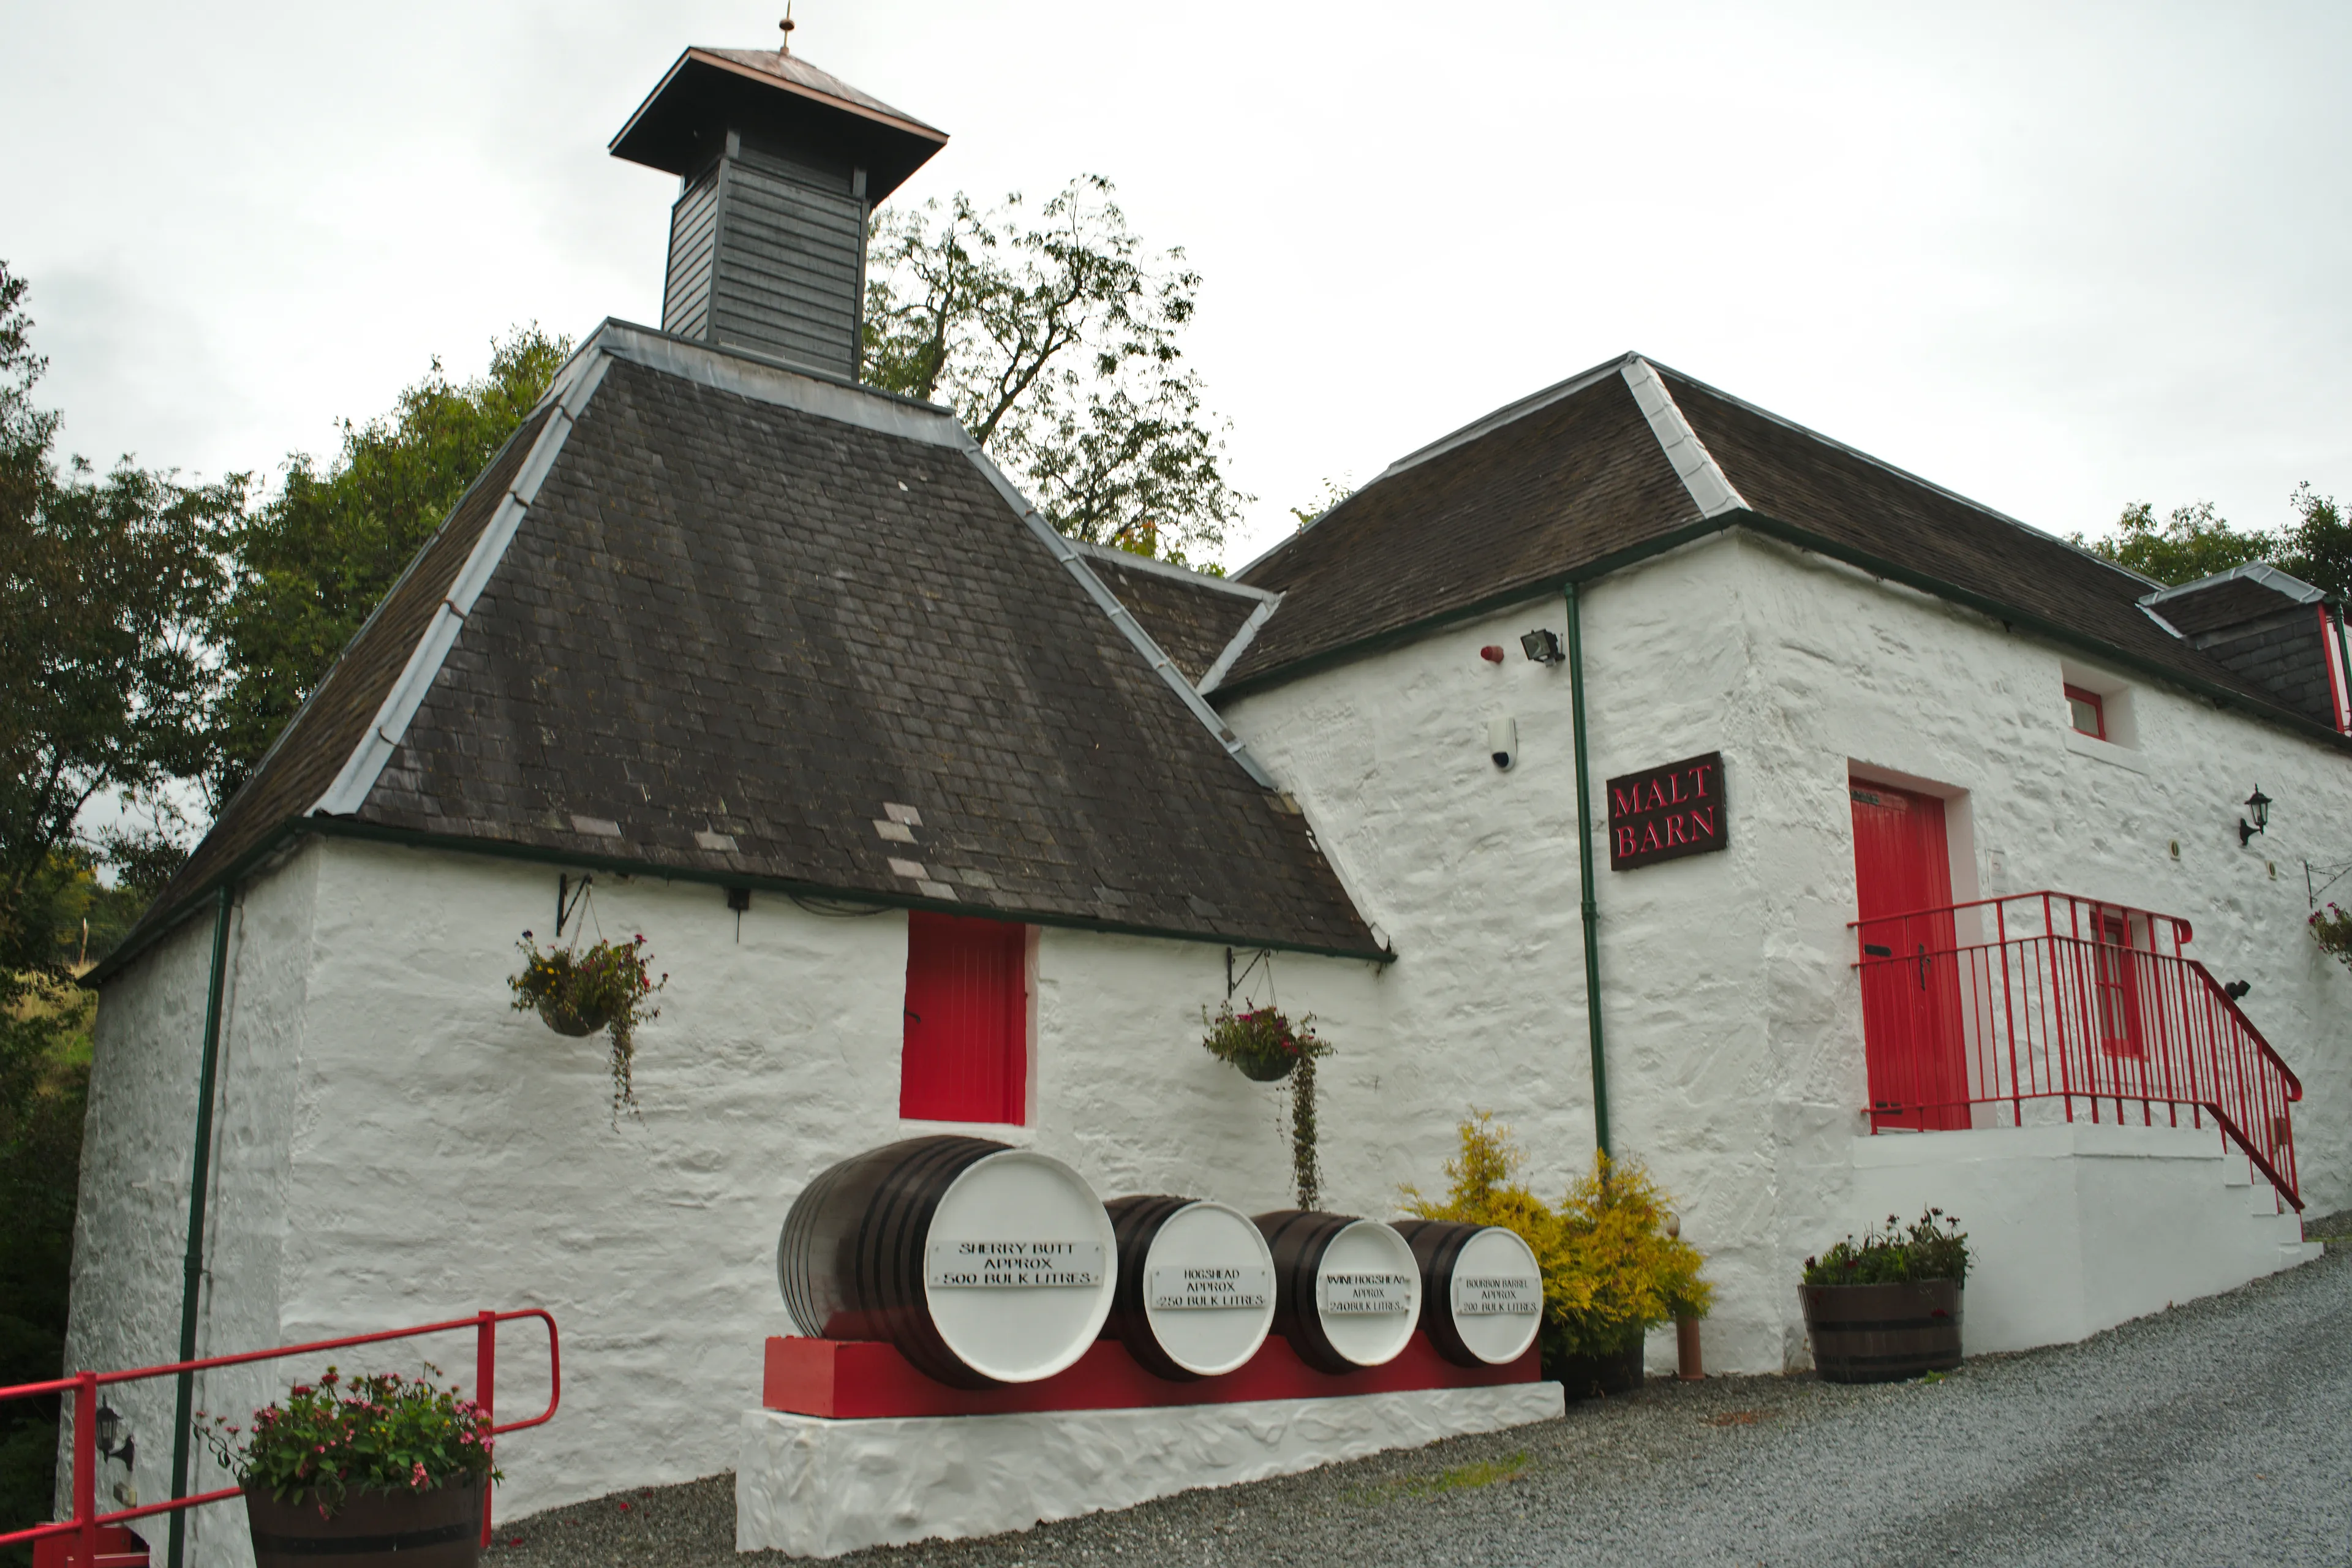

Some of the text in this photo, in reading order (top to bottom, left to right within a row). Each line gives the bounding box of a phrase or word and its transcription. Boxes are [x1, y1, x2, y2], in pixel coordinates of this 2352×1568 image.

[1613, 764, 1711, 818] MALT
[1616, 805, 1714, 858] BARN
[959, 1243, 1075, 1254] SHERRY BUTT
[984, 1257, 1052, 1269] APPROX
[944, 1272, 1090, 1284] 500 BULK LITRES
[1185, 1269, 1240, 1280] HOGSHEAD
[1187, 1281, 1235, 1292] APPROX
[1466, 1279, 1529, 1288] BOURBON BARREL
[1353, 1288, 1384, 1298] APPROX
[1482, 1289, 1517, 1299] APPROX
[1159, 1295, 1264, 1306] 250 BULK LITRES
[1374, 1301, 1400, 1311] LITRES
[1464, 1302, 1537, 1311] 200 BULK LITRES
